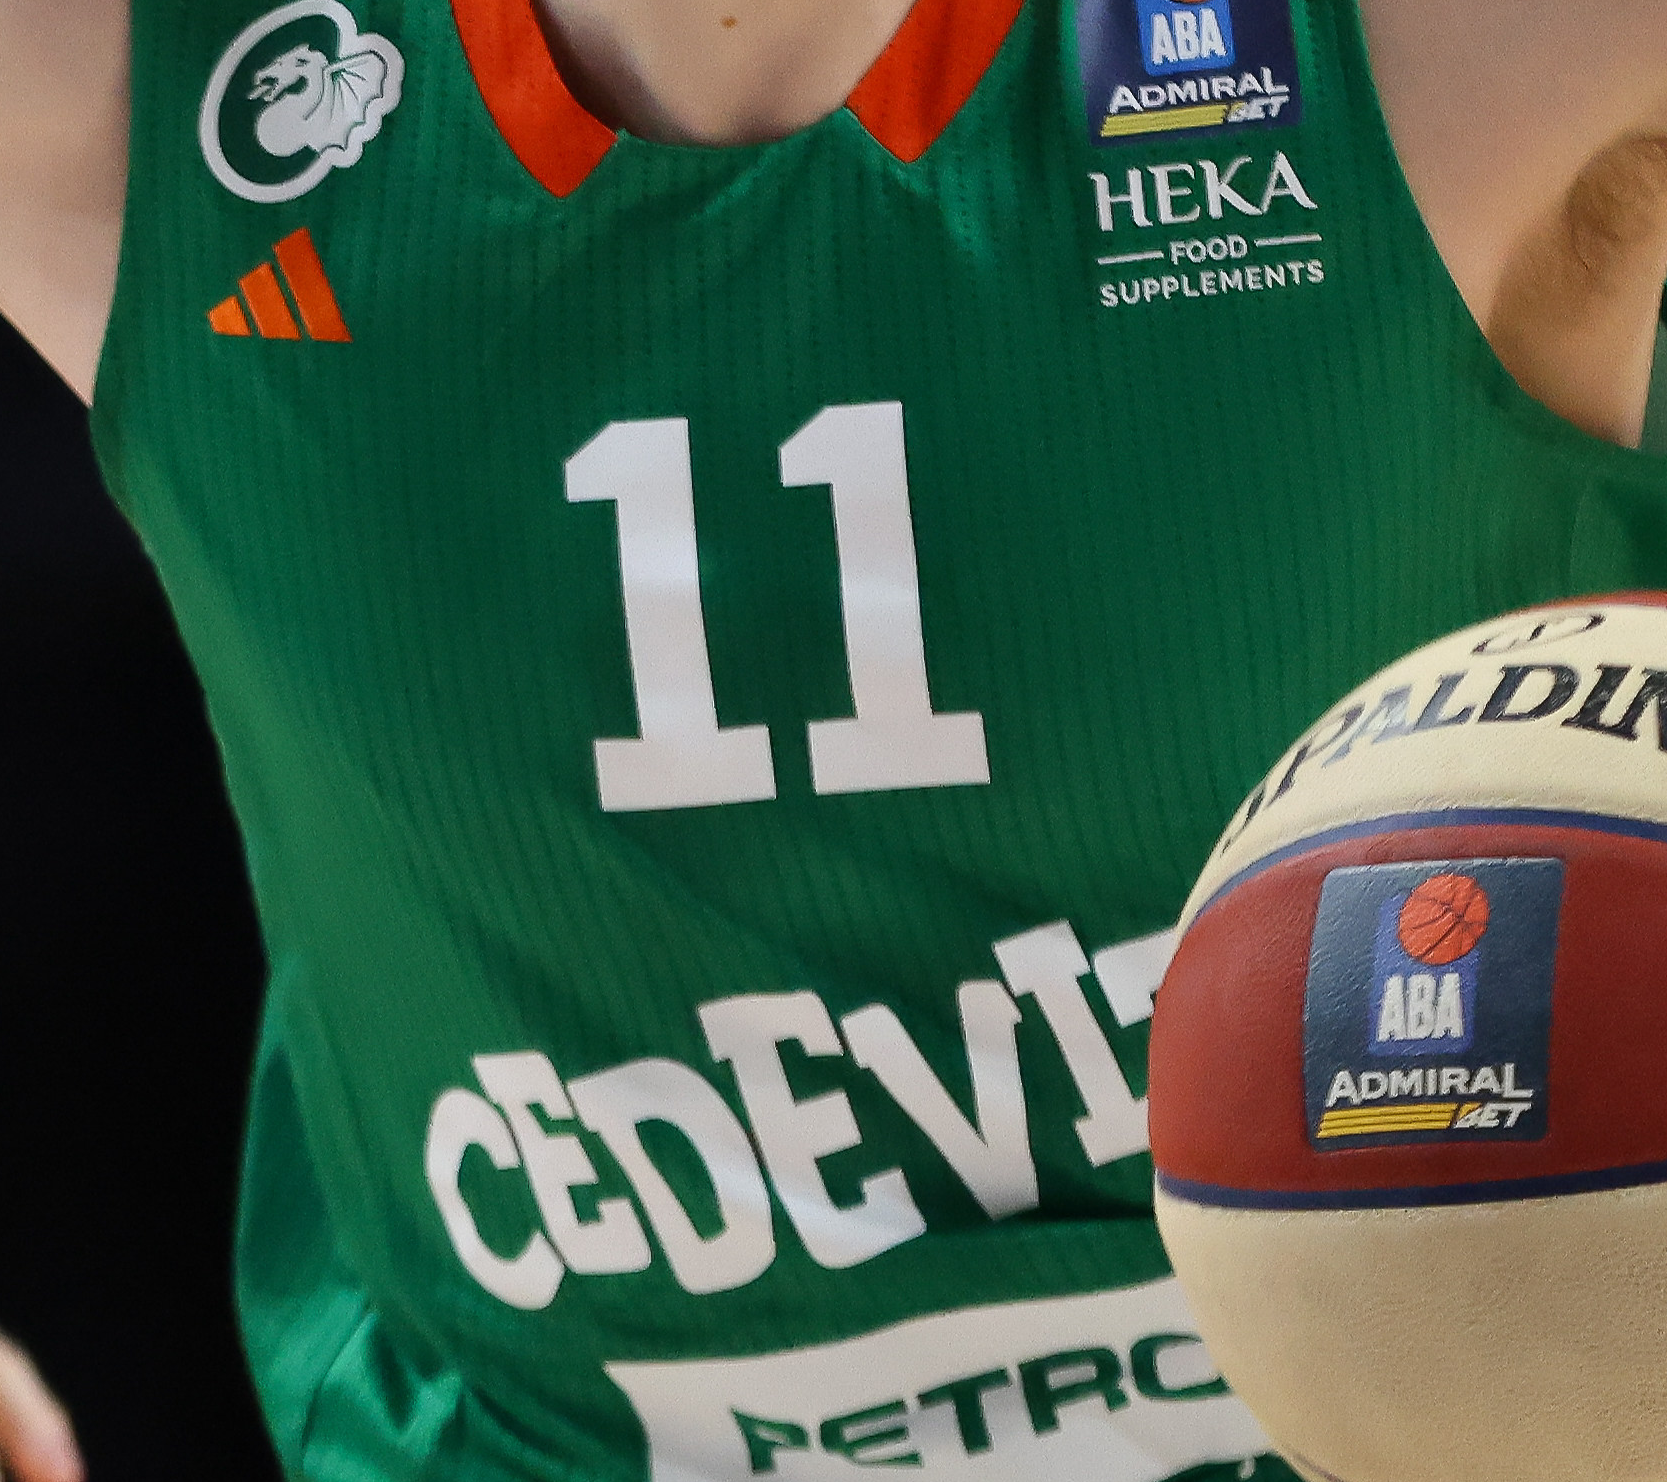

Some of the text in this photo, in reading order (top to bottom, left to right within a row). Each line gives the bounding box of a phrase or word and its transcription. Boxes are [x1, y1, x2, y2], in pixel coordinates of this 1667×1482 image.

[1151, 7, 1227, 65] ABA
[1109, 66, 1290, 114] ADMIRAL
[1088, 150, 1318, 232] HEKA
[1170, 234, 1248, 265] FOOD
[1099, 259, 1325, 307] SUPPLEMENTS
[564, 400, 991, 813] 11
[1377, 972, 1464, 1042] ABA
[1325, 1062, 1534, 1108] ADMIRAL
